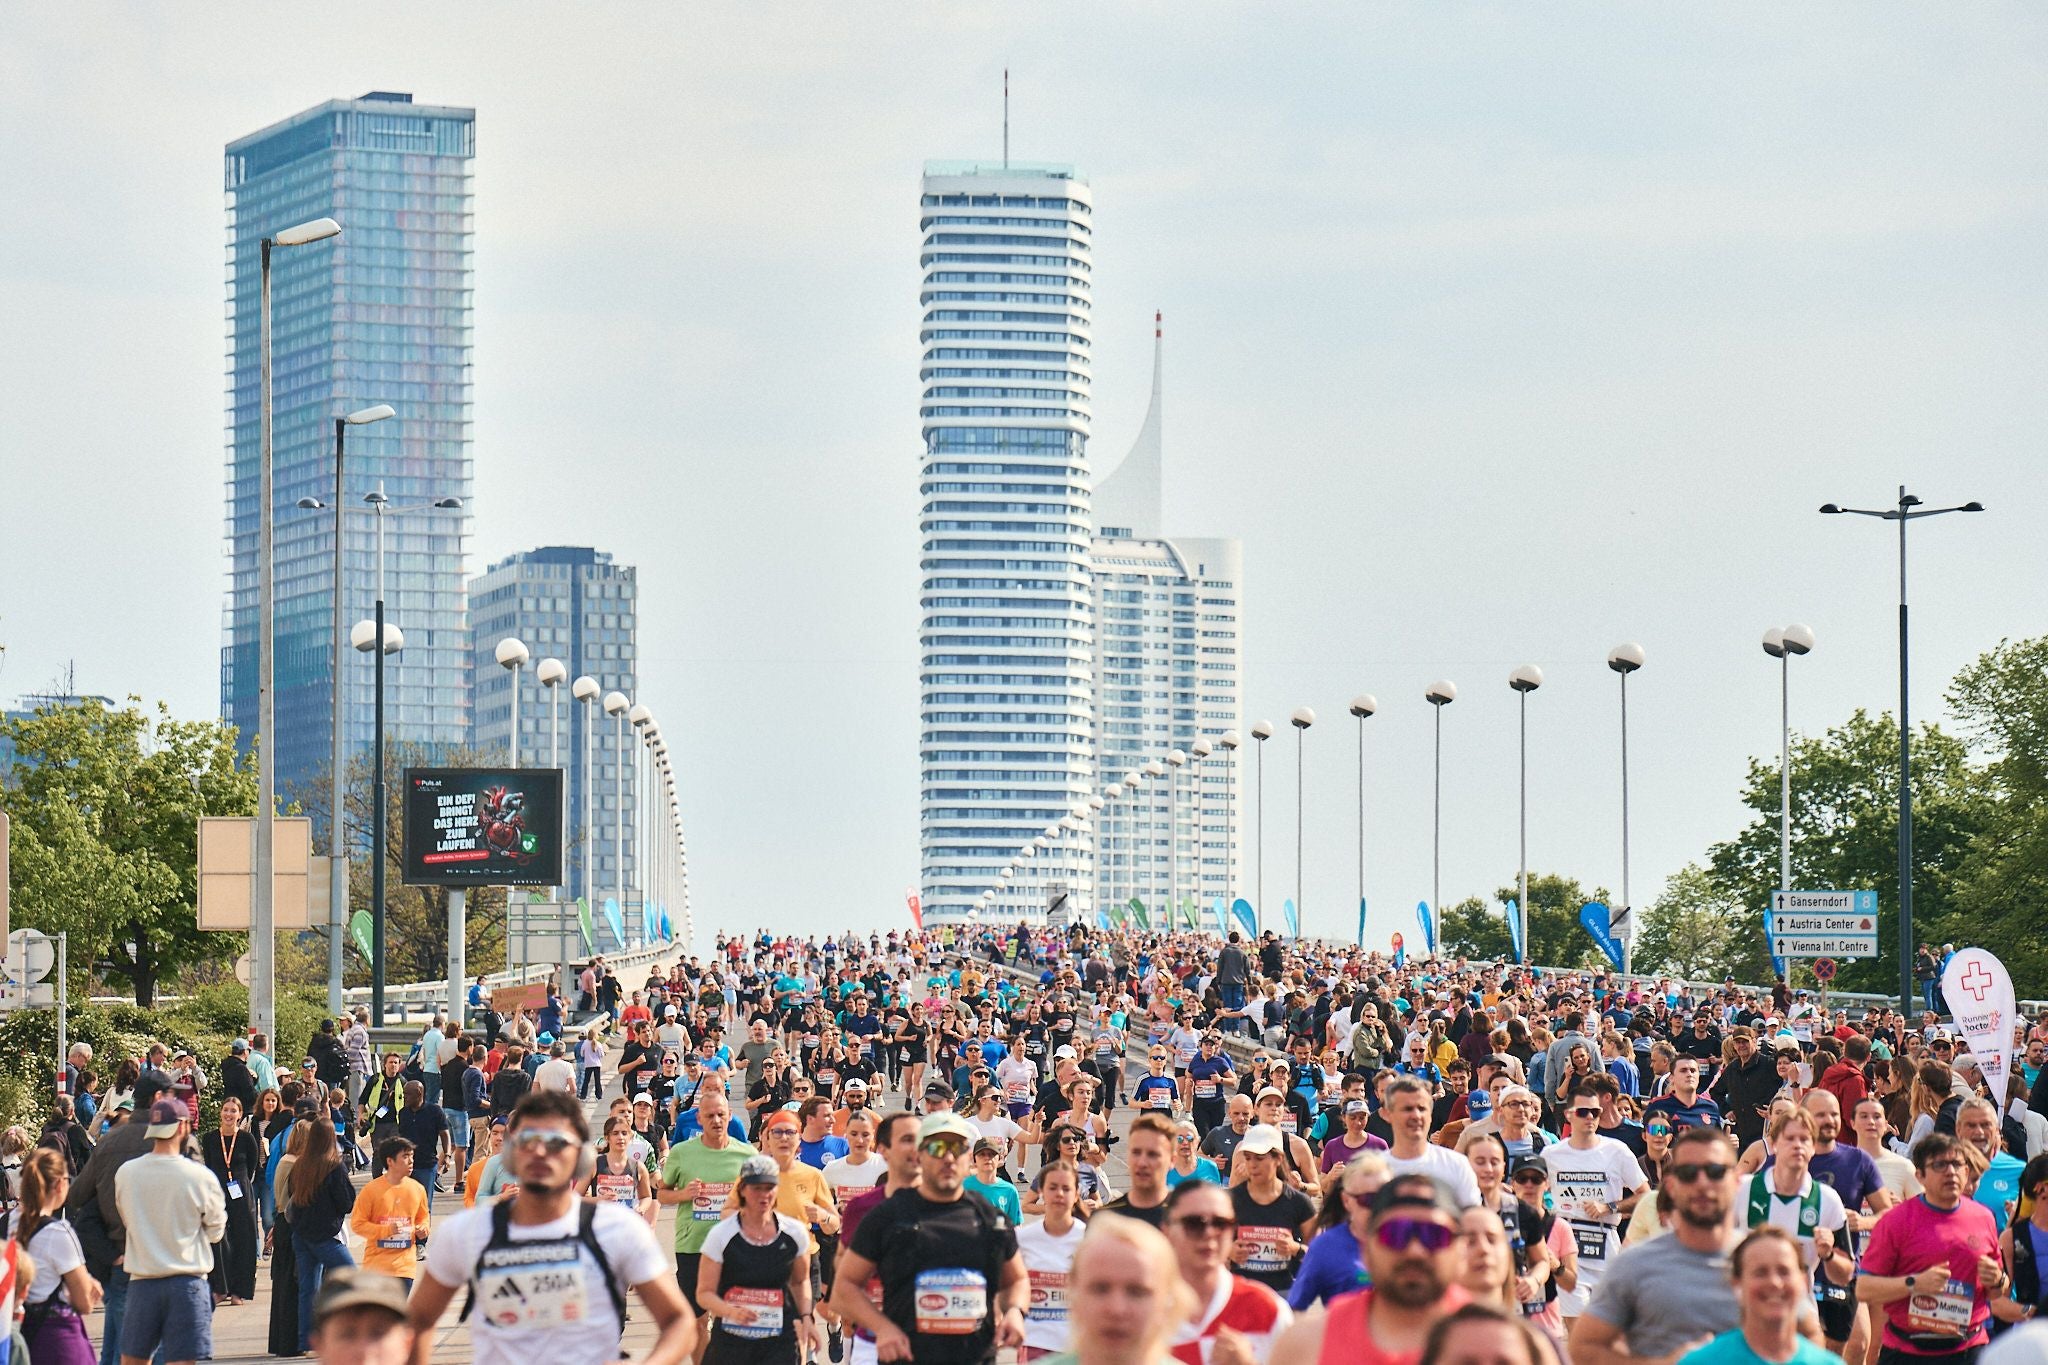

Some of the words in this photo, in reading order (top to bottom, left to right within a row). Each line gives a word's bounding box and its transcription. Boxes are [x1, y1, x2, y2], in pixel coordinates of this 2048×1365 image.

[437, 795, 454, 807] EIN
[455, 793, 476, 805] DEFI
[440, 804, 473, 817] BRINGT
[433, 817, 454, 829] DAS
[454, 815, 479, 827] HERZ
[445, 828, 467, 839] ZUM
[436, 838, 476, 852] LAUFEN!
[1862, 895, 1871, 909] 8
[1790, 918, 1821, 929] Austria
[1825, 918, 1855, 929] Center
[1791, 940, 1821, 952] Vienna
[1823, 940, 1838, 952] Int.
[1839, 940, 1869, 952] Centre
[1558, 1173, 1604, 1181] POWERADE
[1580, 1187, 1604, 1197] 251A
